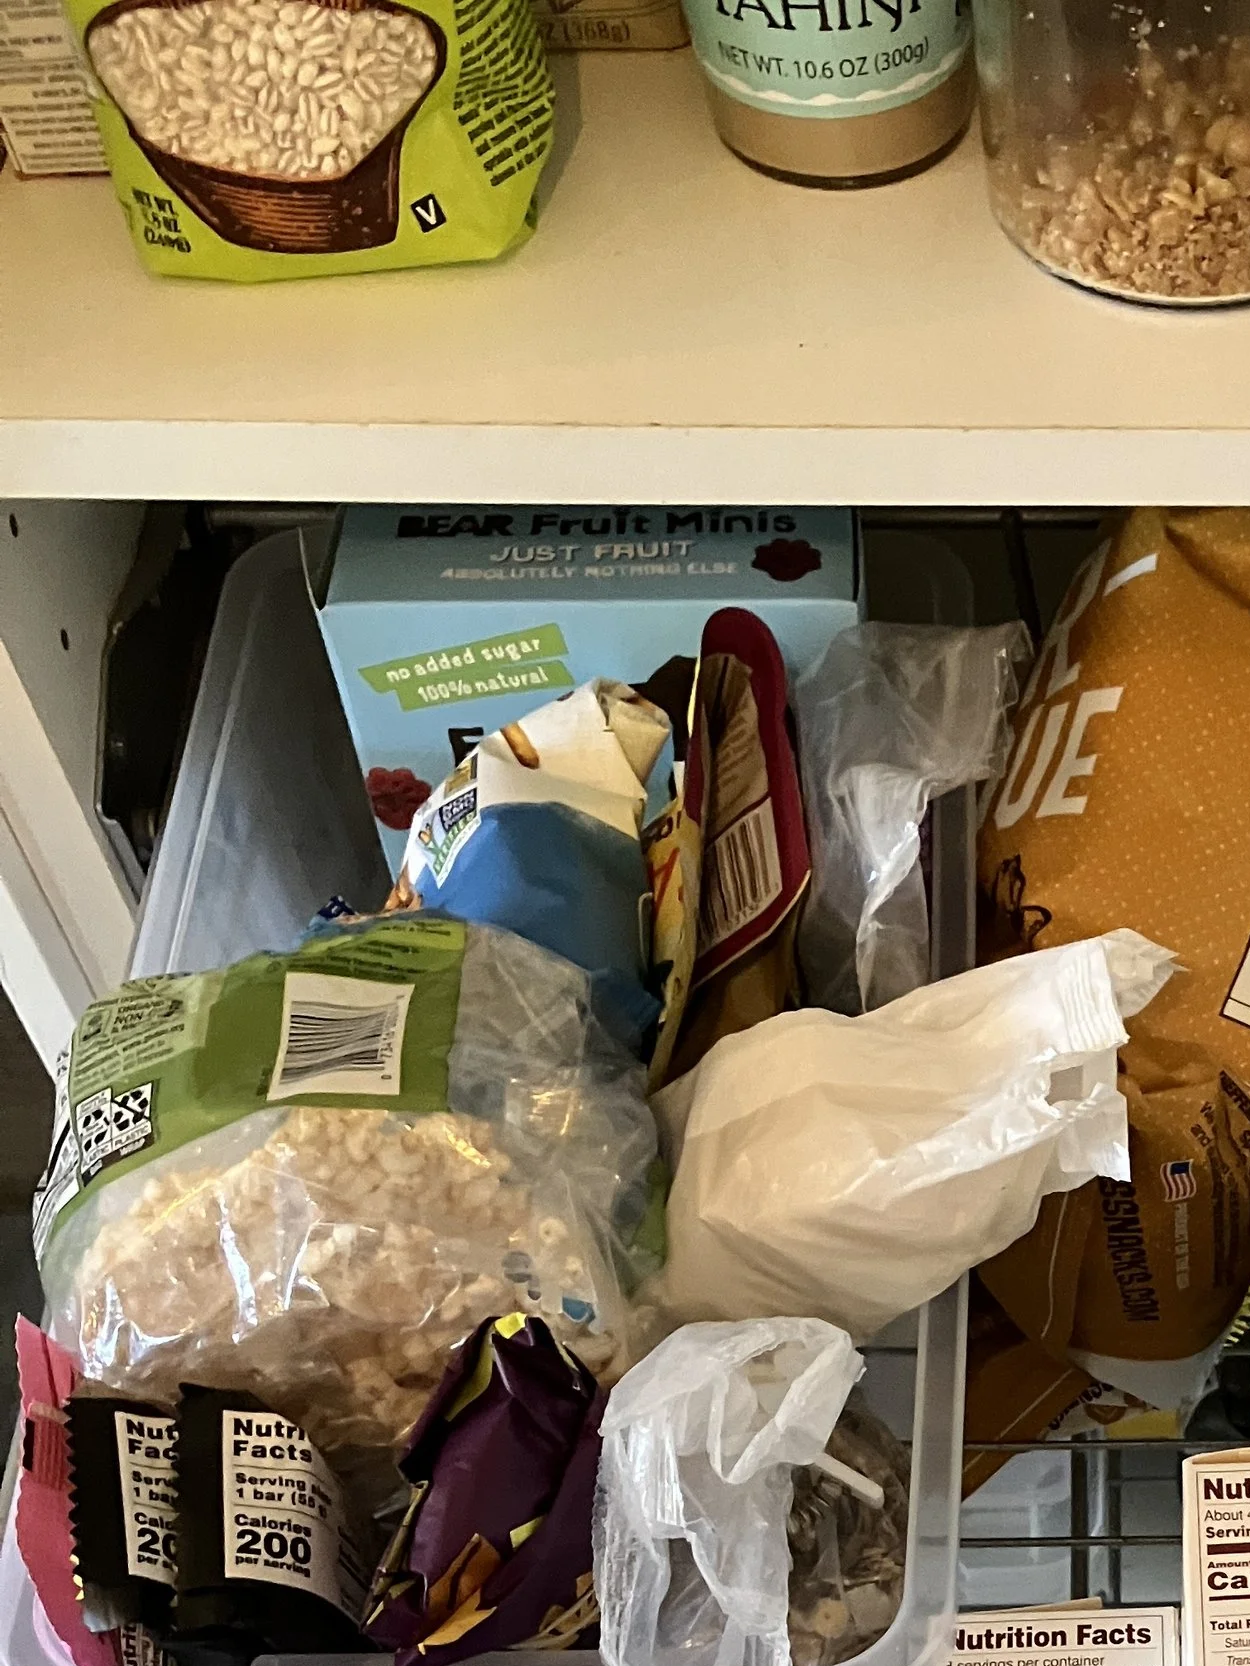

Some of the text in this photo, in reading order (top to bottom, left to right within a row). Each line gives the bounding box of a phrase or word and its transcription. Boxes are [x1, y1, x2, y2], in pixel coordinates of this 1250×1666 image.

[718, 40, 749, 68] NET
[793, 60, 833, 79] 10.6
[839, 57, 869, 78] OZ
[874, 37, 929, 74] (300g)
[397, 513, 514, 539] BEAR
[666, 510, 797, 535] Minis
[490, 539, 696, 563] JUST FRUIT
[441, 561, 738, 581] ABSOLUTELY NOTHING ELSE
[386, 636, 542, 683] no added sugar
[416, 666, 548, 702] 100% natural
[233, 1440, 312, 1463] Facts
[234, 1514, 311, 1537] Calories
[1204, 1510, 1243, 1522] About
[236, 1530, 311, 1565] 200
[235, 1556, 311, 1578] per serving
[1077, 1624, 1151, 1646] Facts
